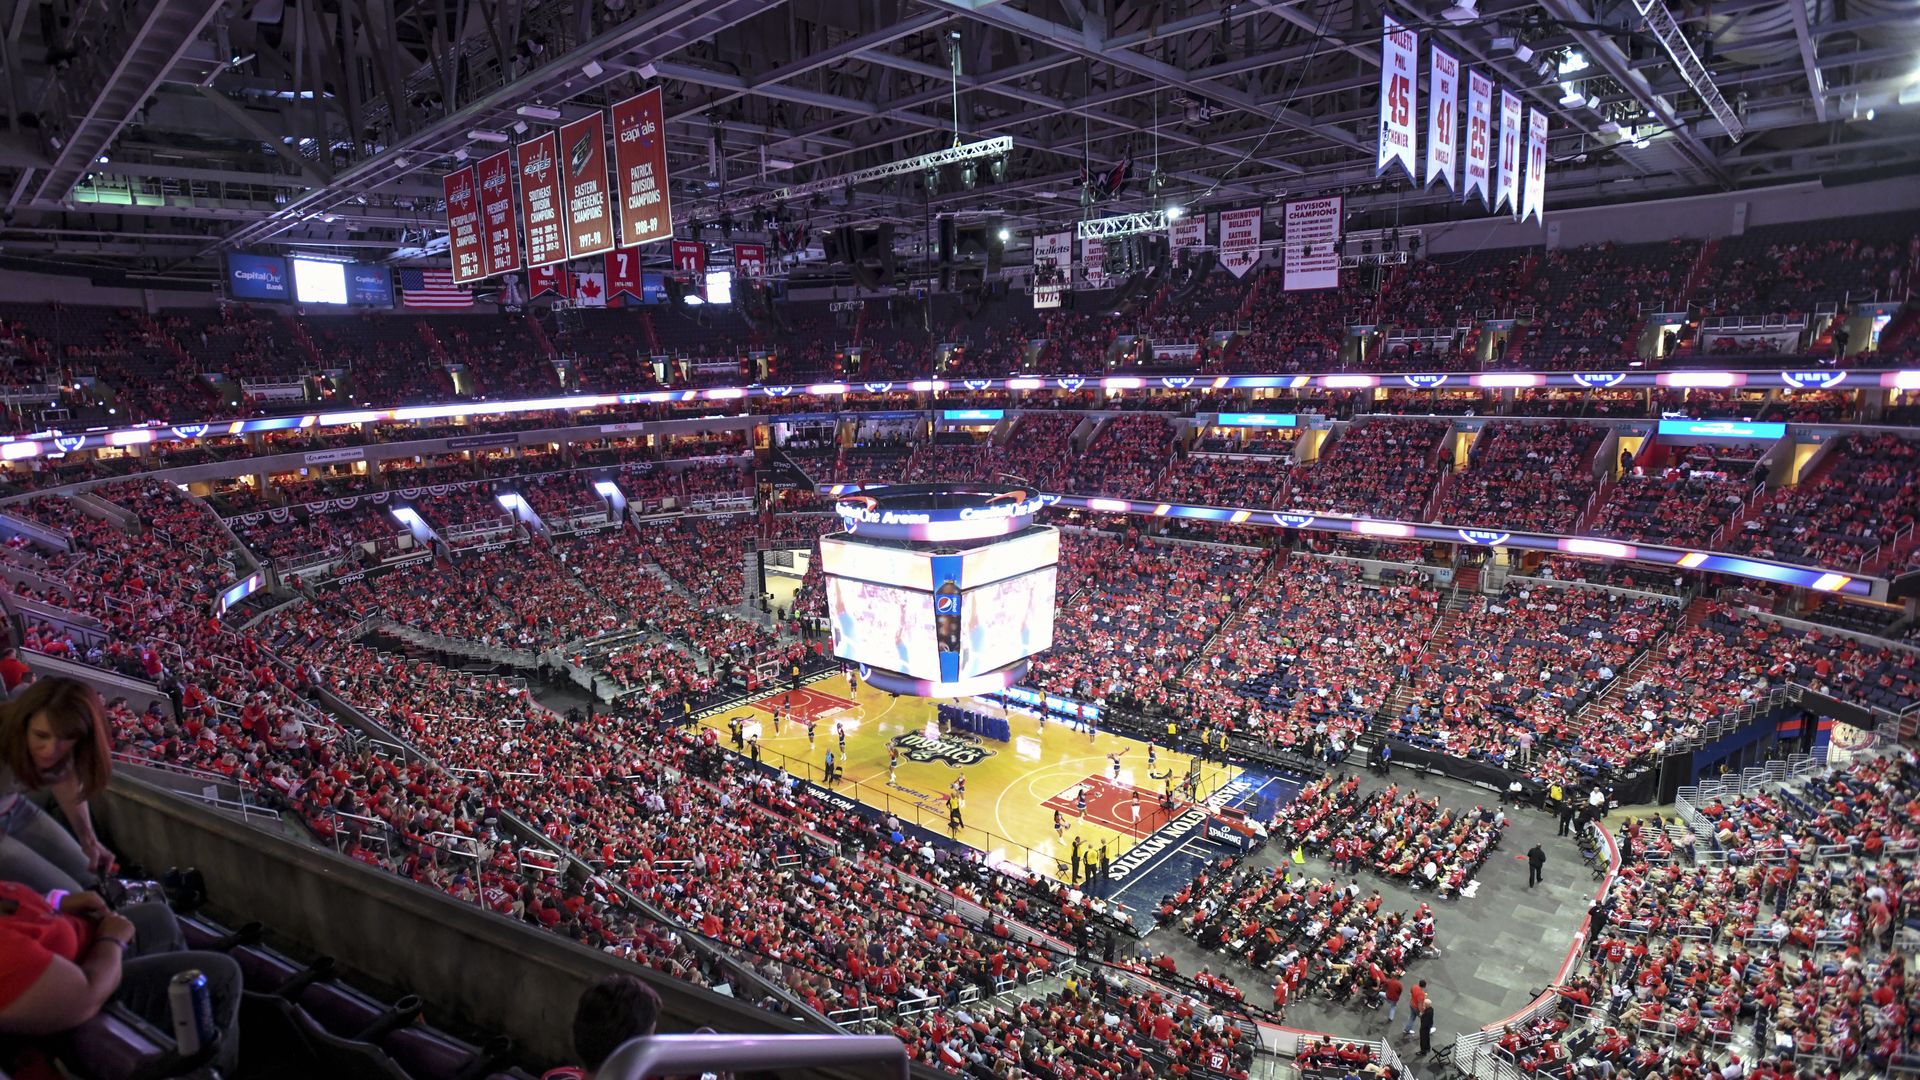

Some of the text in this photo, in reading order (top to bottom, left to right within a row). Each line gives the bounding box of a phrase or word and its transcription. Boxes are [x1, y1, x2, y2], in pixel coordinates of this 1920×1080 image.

[1390, 24, 1412, 52] BULLETS
[1395, 52, 1406, 71] PHIL
[1436, 53, 1455, 78] BULLETS
[1440, 78, 1449, 94] WES
[1472, 77, 1488, 98] BULLETS
[1388, 73, 1409, 127] 45
[1504, 95, 1519, 115] BULLETS
[1437, 98, 1451, 145] 41
[1471, 116, 1486, 161] 25
[1435, 148, 1449, 164] UNSELD
[1504, 132, 1514, 172] 11
[1531, 144, 1542, 182] 10
[630, 162, 653, 181] PATRICK
[529, 185, 551, 202] SOUTHEAST
[574, 180, 597, 198] EASTERN
[632, 176, 655, 195] DIVISION
[532, 197, 551, 212] DIVISION
[571, 191, 604, 212] CONFERENCE
[629, 189, 661, 209] CHAMPIONS
[1295, 201, 1331, 211] DIVISION
[531, 208, 555, 223] CHAMPIONS
[574, 206, 603, 224] CHAMPIONS
[1171, 216, 1205, 227] WASHINGTON
[1221, 210, 1260, 220] WASHINGTON
[1289, 208, 1337, 219] CHAMPIONS
[635, 217, 658, 235] 1988-89
[1176, 226, 1198, 234] BULLETS
[1229, 219, 1252, 228] BULLETS
[579, 231, 601, 248] 1997-98
[1222, 238, 1257, 247] CONFERENCE
[1229, 231, 1251, 239] EASTERN
[460, 252, 477, 265] 2015-16
[1035, 246, 1070, 255] bullets
[617, 253, 629, 278] 7
[681, 257, 696, 270] 11
[266, 283, 283, 291] Bank
[882, 511, 930, 524] Arena
[477, 544, 506, 552] ETIHAD
[339, 574, 364, 584] ETIHAD
[690, 670, 841, 720] WASHINGTON MSTICS
[900, 734, 981, 763] mystics
[546, 827, 557, 836] 77
[1108, 781, 1252, 881] WASHGTON MYSTICS
[1208, 826, 1242, 845] SPALDING
[1335, 843, 1345, 853] 77
[882, 975, 892, 985] 21
[1554, 1047, 1560, 1058] 8
[1211, 1057, 1223, 1069] 92
